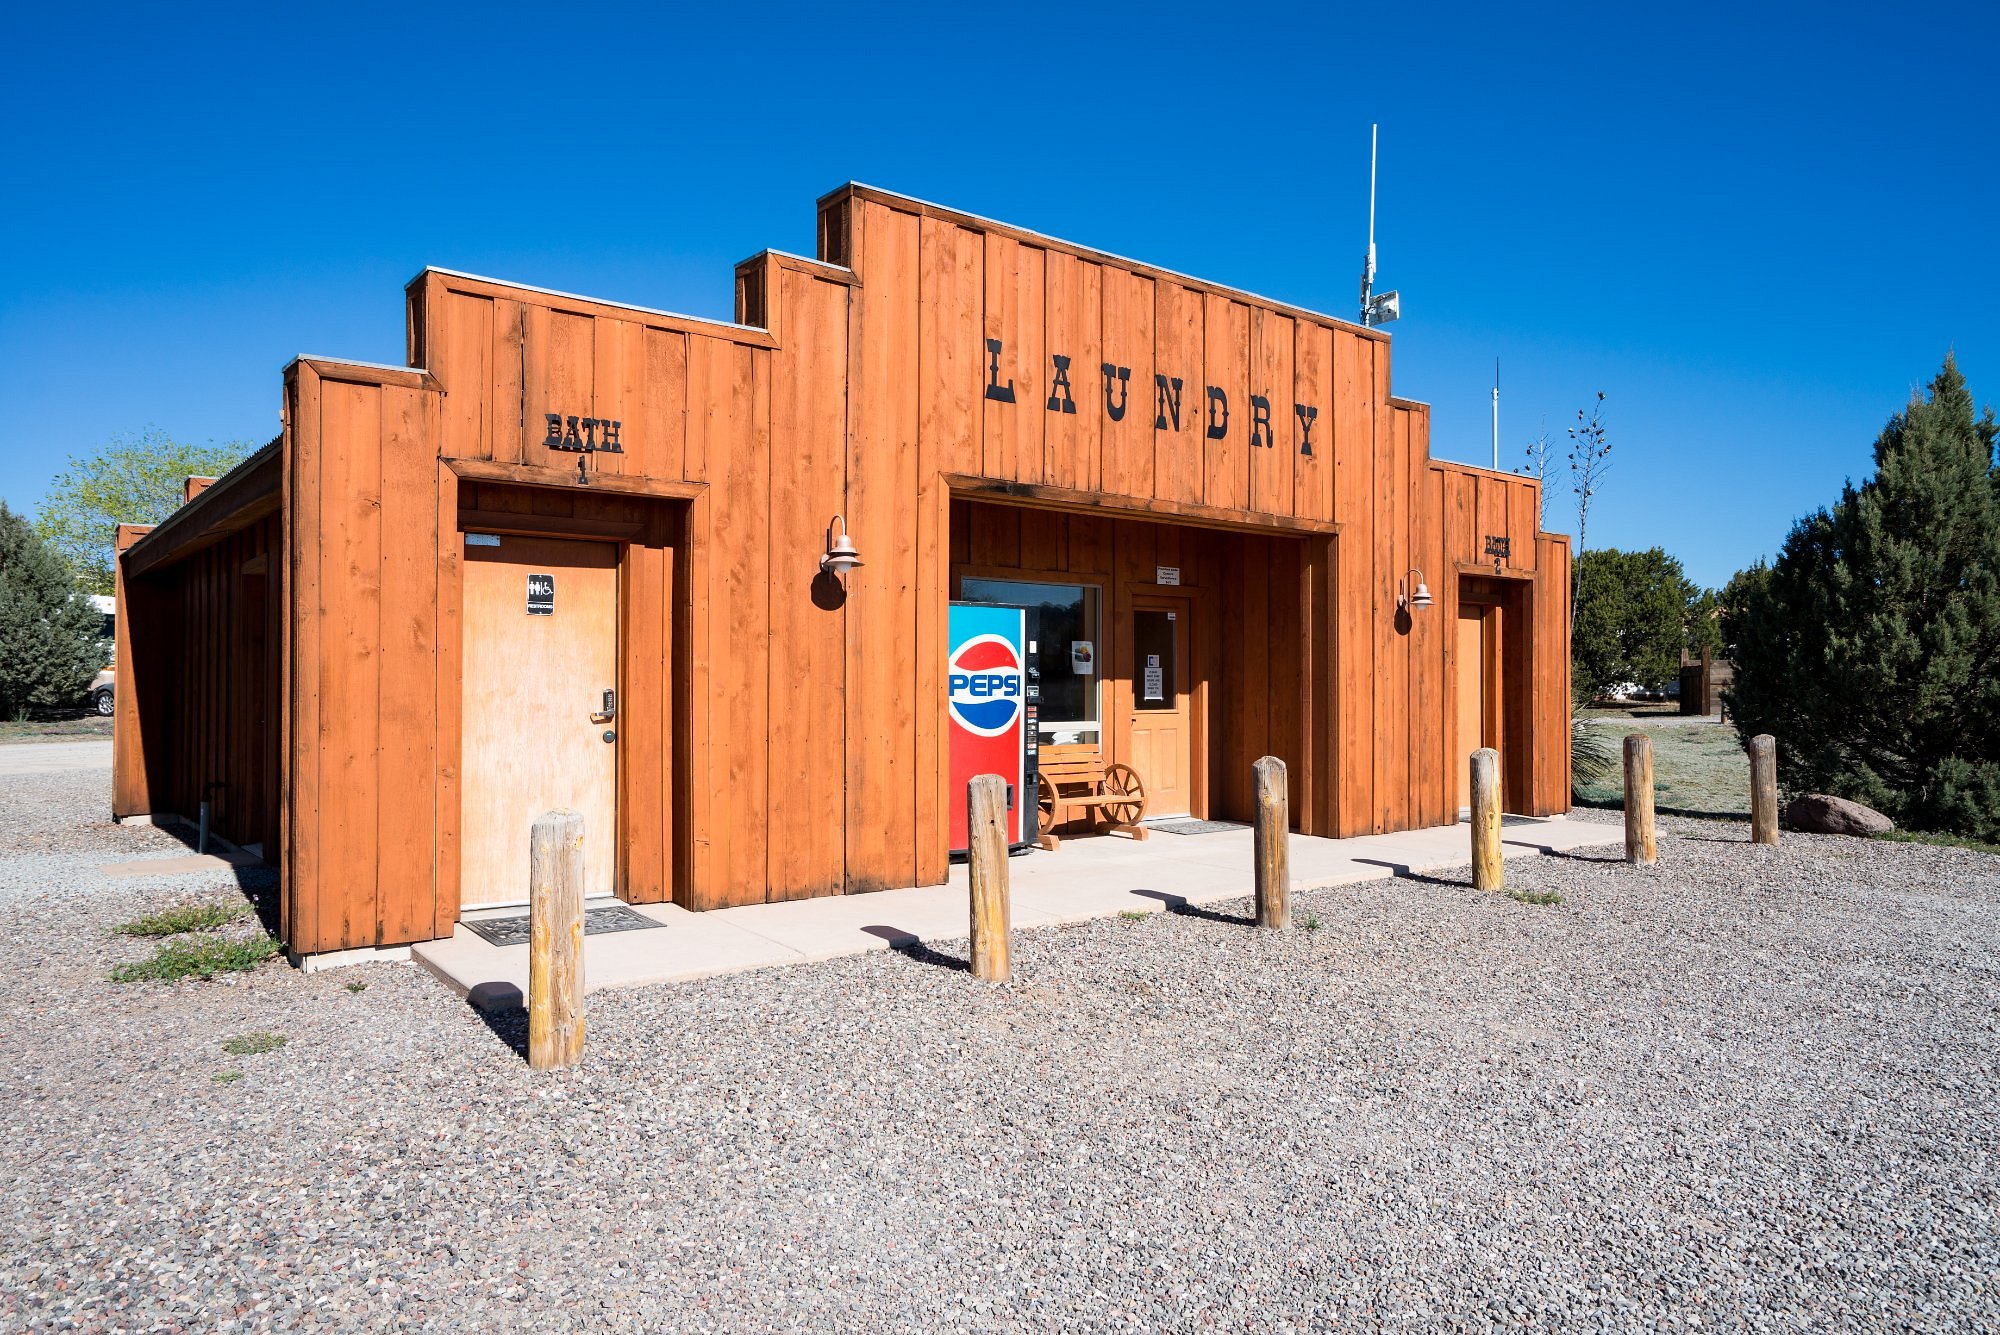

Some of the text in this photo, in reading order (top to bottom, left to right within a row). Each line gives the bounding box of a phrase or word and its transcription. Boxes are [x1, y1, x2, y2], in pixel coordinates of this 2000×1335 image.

[985, 338, 1318, 456] LAUNDRY
[543, 414, 623, 452] BATH
[578, 455, 589, 485] 1
[1494, 558, 1501, 575] 2
[949, 674, 1021, 697] PEPSI
